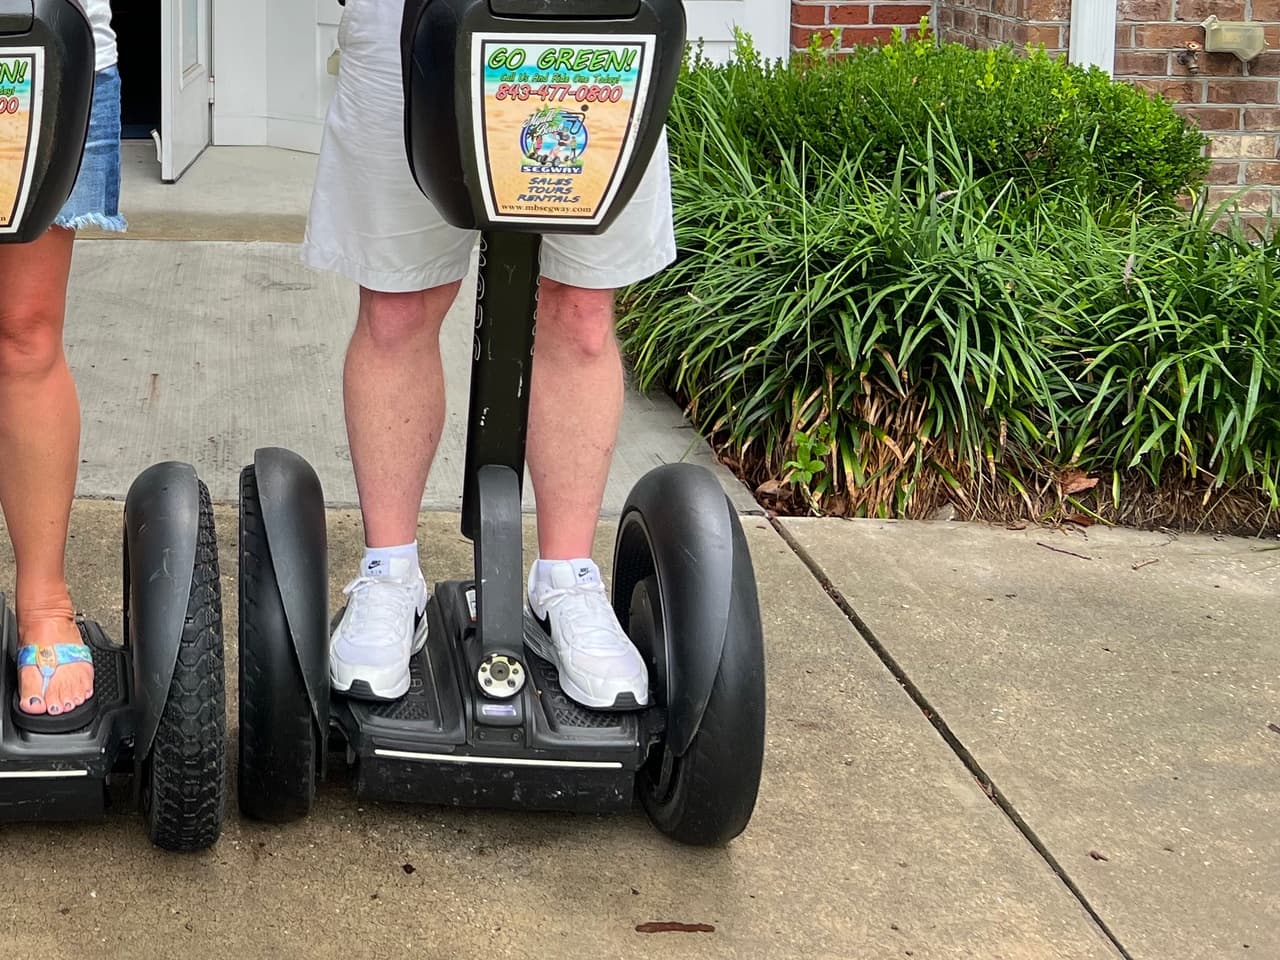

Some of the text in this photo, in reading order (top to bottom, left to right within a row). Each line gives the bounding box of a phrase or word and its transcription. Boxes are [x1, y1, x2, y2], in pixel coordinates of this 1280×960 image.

[488, 48, 637, 72] GO GREEN!
[593, 74, 620, 85] Today!
[495, 84, 623, 103] 843-477-0800
[528, 177, 573, 186] SALES
[528, 186, 573, 195] TOURS
[517, 194, 580, 203] RENTALS
[501, 204, 592, 213] www.mbsegway.com
